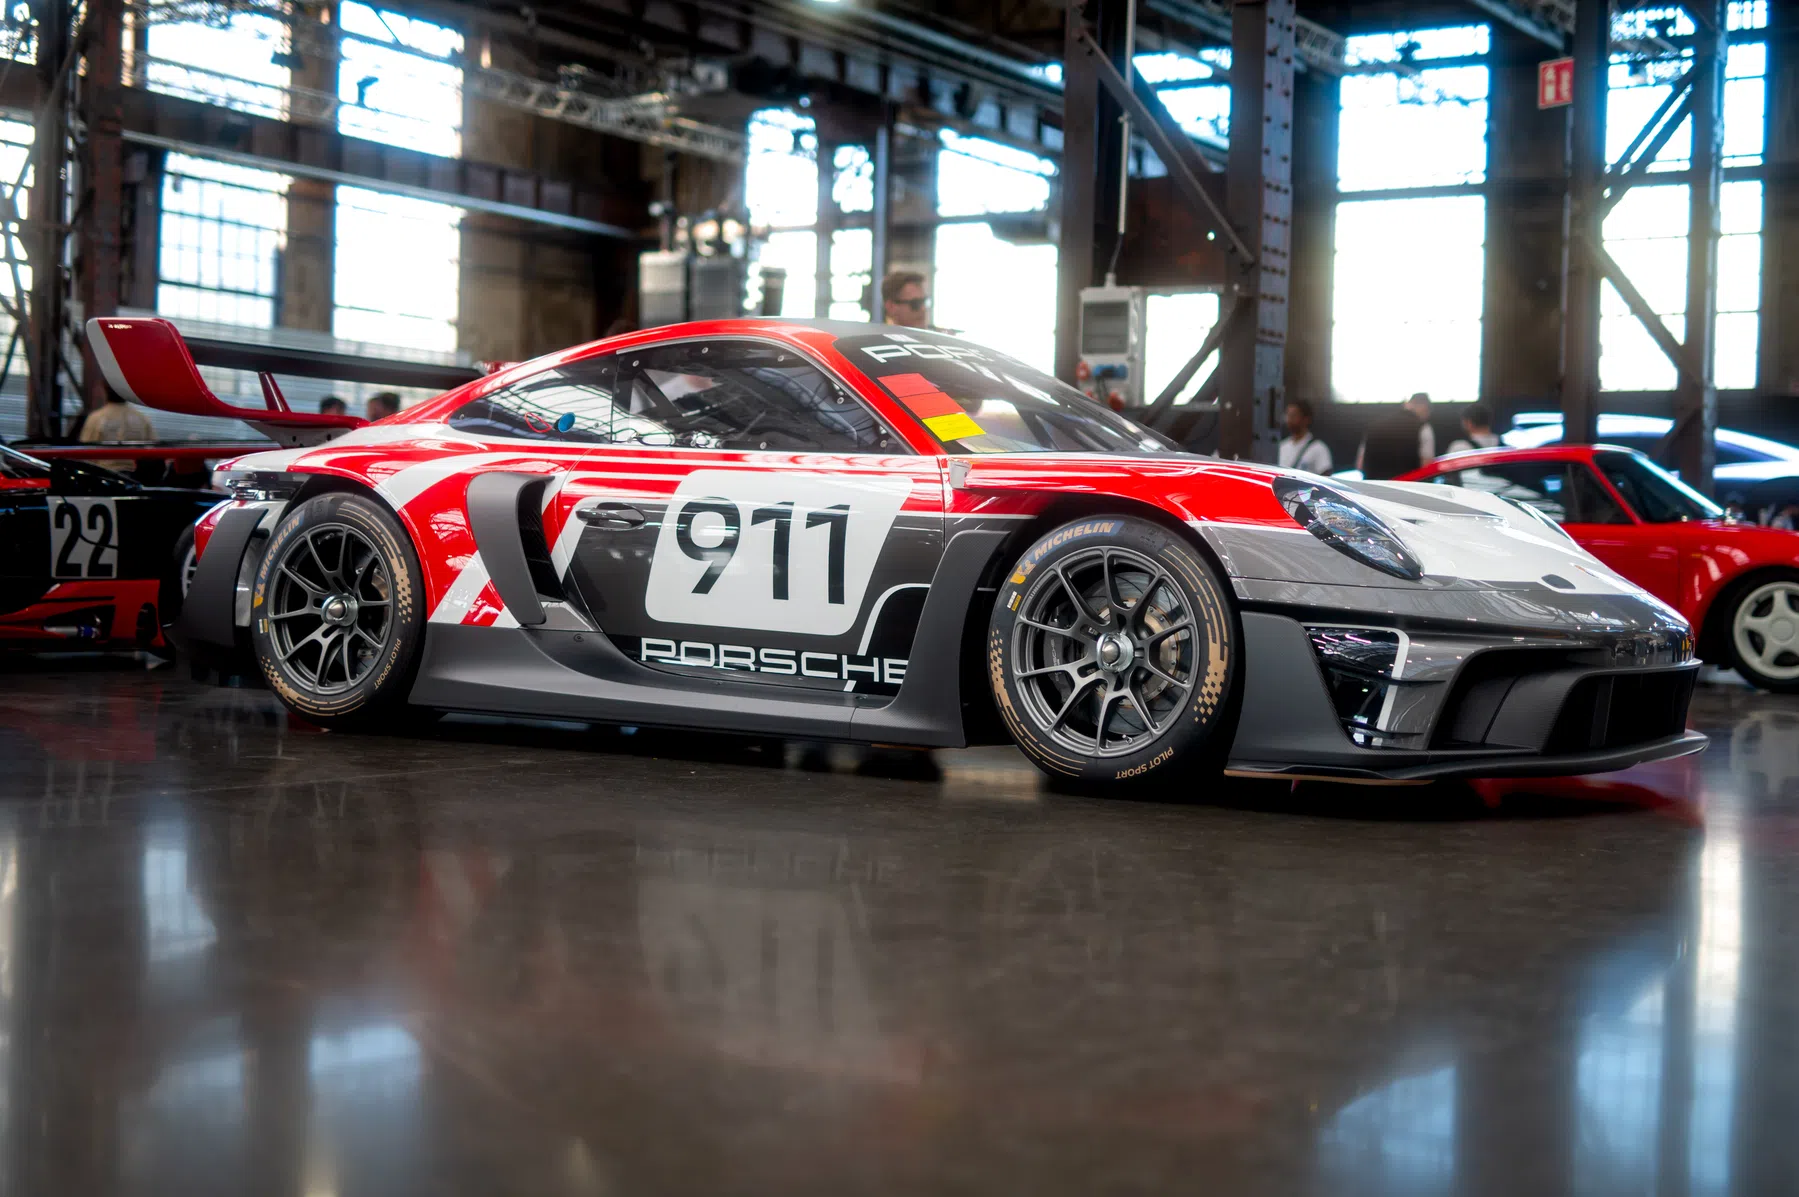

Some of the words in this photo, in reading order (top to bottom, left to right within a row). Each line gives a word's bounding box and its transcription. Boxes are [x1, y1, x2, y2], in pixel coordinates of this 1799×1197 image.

[54, 503, 114, 577] 22
[260, 516, 300, 580] MICHELIN
[676, 496, 851, 605] 911
[1034, 522, 1115, 561] MICHELIN
[389, 638, 402, 665] PILOT
[641, 637, 909, 684] PORSCHE
[374, 663, 391, 690] SPORT
[1115, 763, 1148, 779] SPORT
[1149, 746, 1174, 770] PILOT
